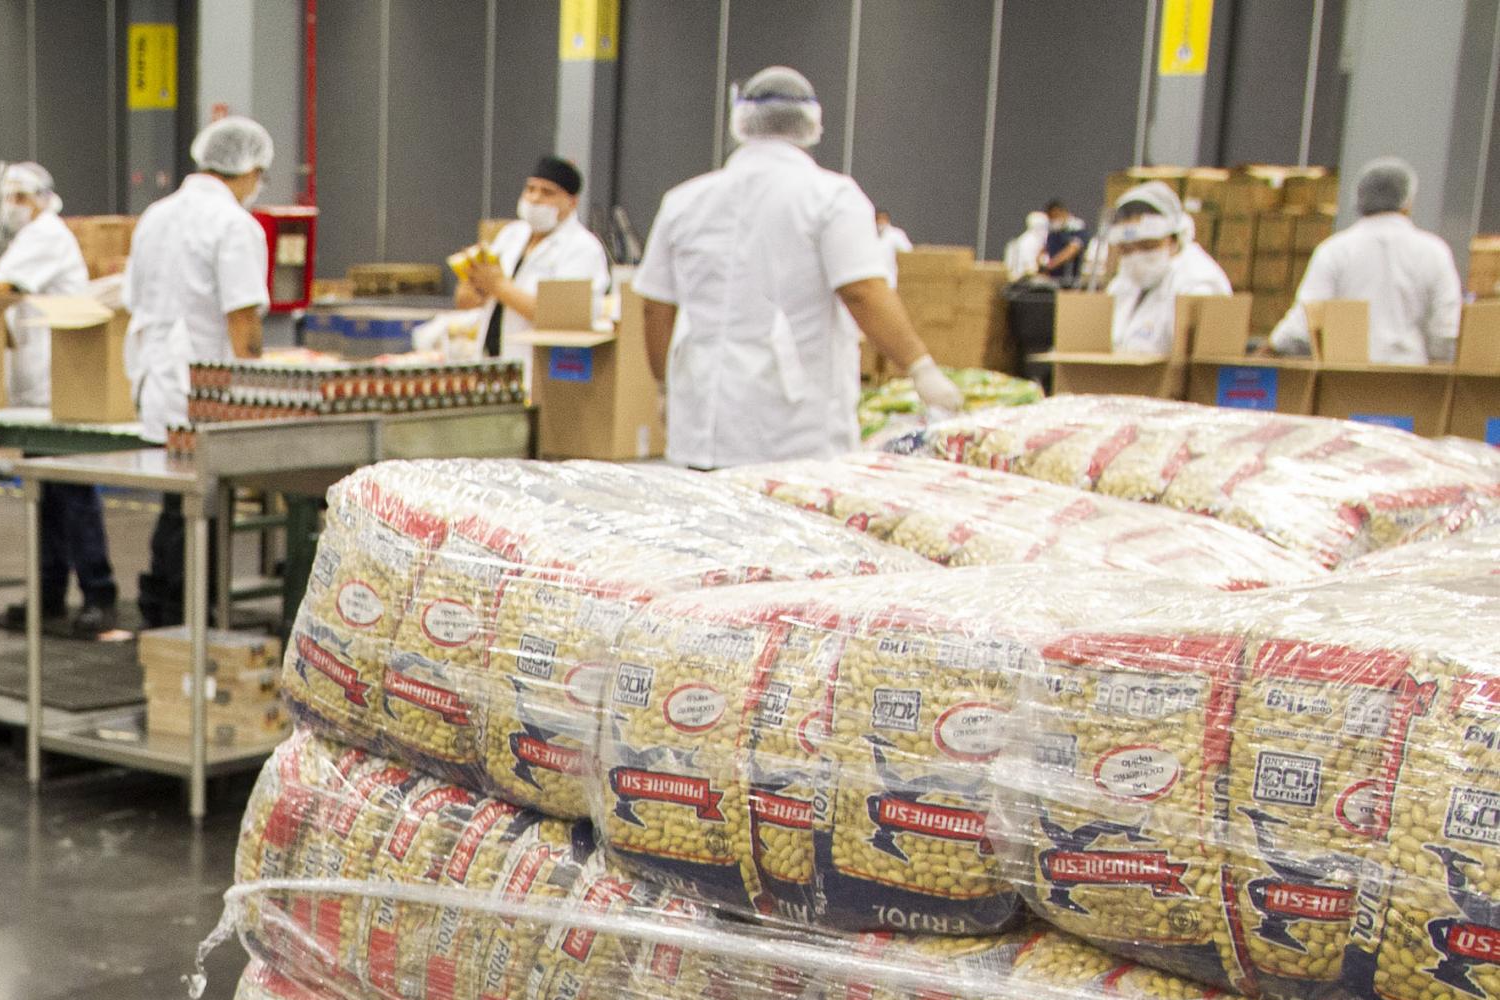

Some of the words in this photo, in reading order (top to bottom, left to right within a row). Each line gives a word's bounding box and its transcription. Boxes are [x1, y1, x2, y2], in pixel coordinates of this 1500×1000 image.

[621, 776, 704, 800] PROGRESO
[1261, 787, 1310, 801] FRIJOL
[754, 796, 813, 822] OGRES
[884, 804, 984, 837] PROGRESO
[1052, 858, 1160, 877] PROGRESO
[1273, 889, 1348, 914] GRESO
[434, 904, 462, 955] RIJOL
[872, 903, 966, 934] FRIJOL
[485, 937, 510, 990] FRIJOL
